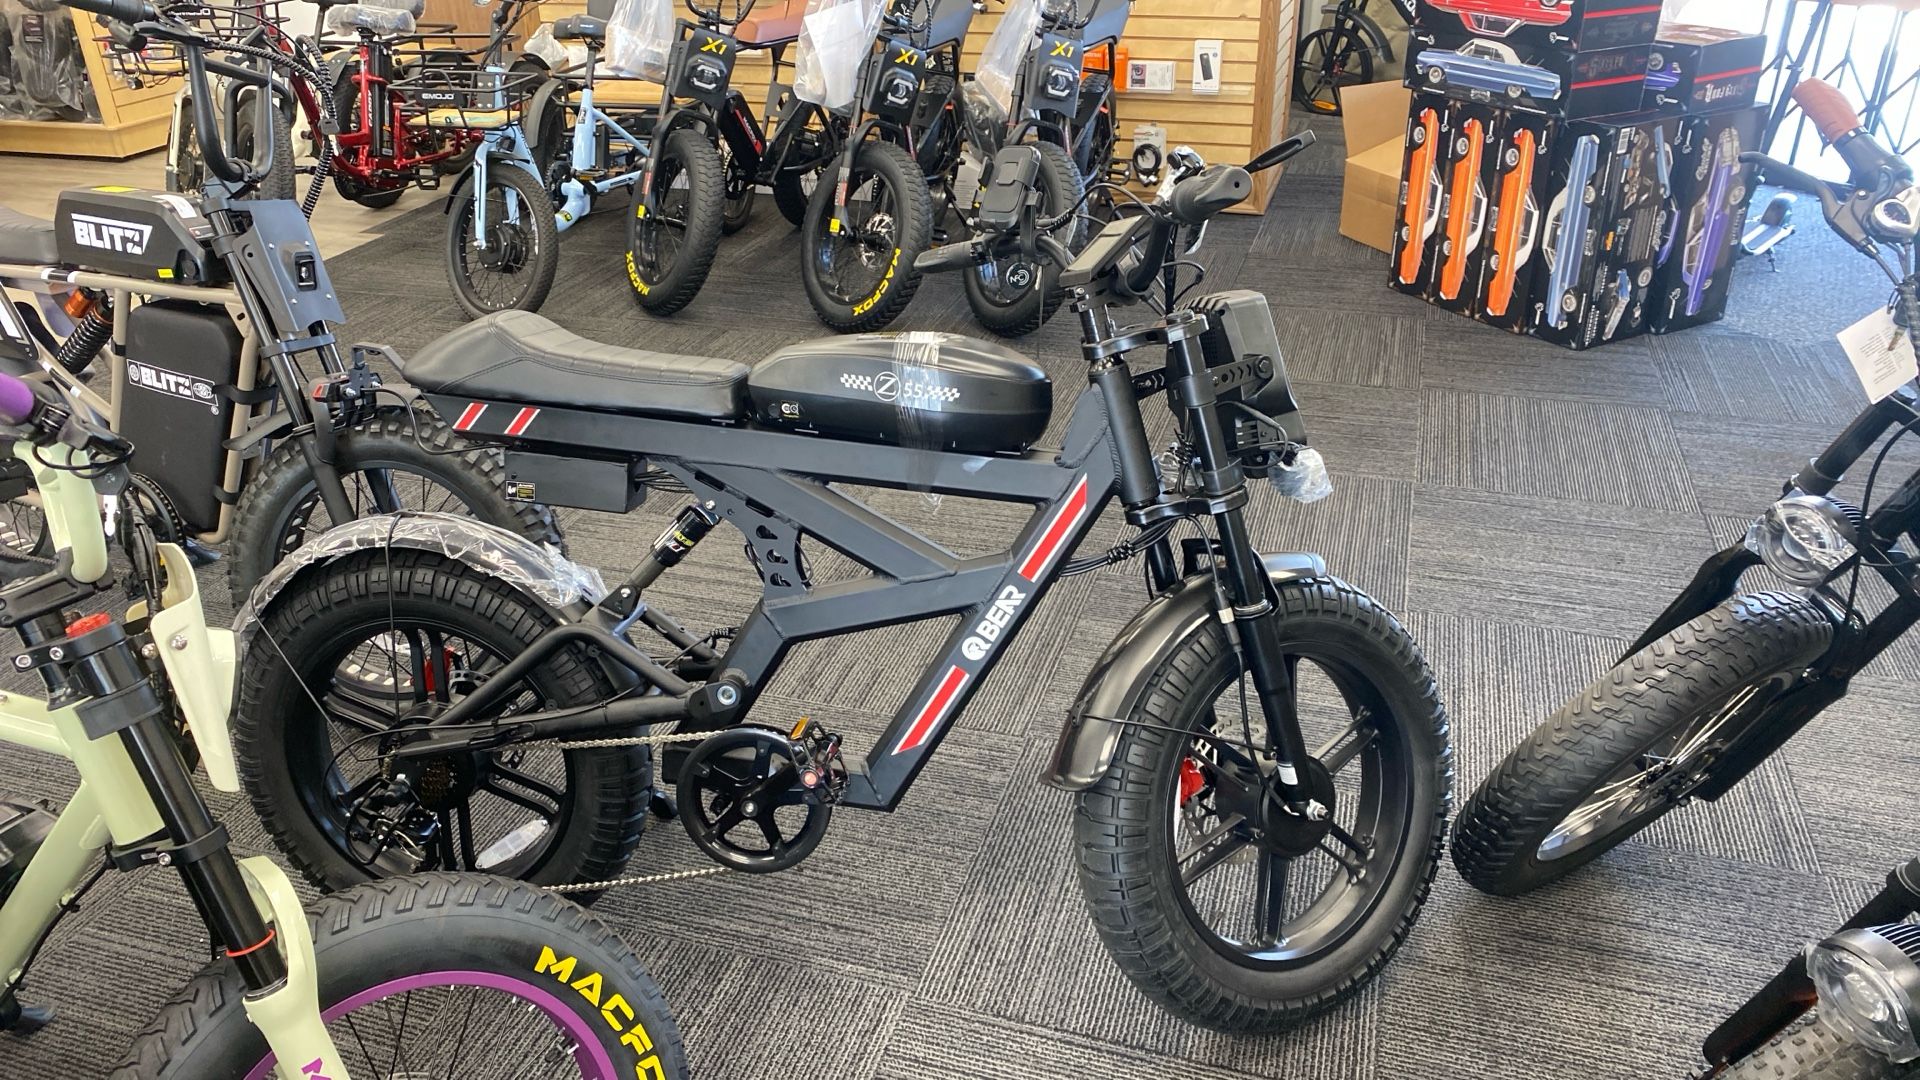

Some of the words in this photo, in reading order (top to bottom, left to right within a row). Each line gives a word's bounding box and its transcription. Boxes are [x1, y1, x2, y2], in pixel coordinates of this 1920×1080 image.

[700, 36, 727, 55] X1
[894, 47, 918, 66] X1
[1050, 40, 1074, 58] X1
[72, 217, 148, 255] BLITZ
[625, 250, 650, 296] MACFOX
[852, 248, 901, 316] MACFOX
[140, 365, 192, 397] BLITZ
[904, 379, 923, 398] 55
